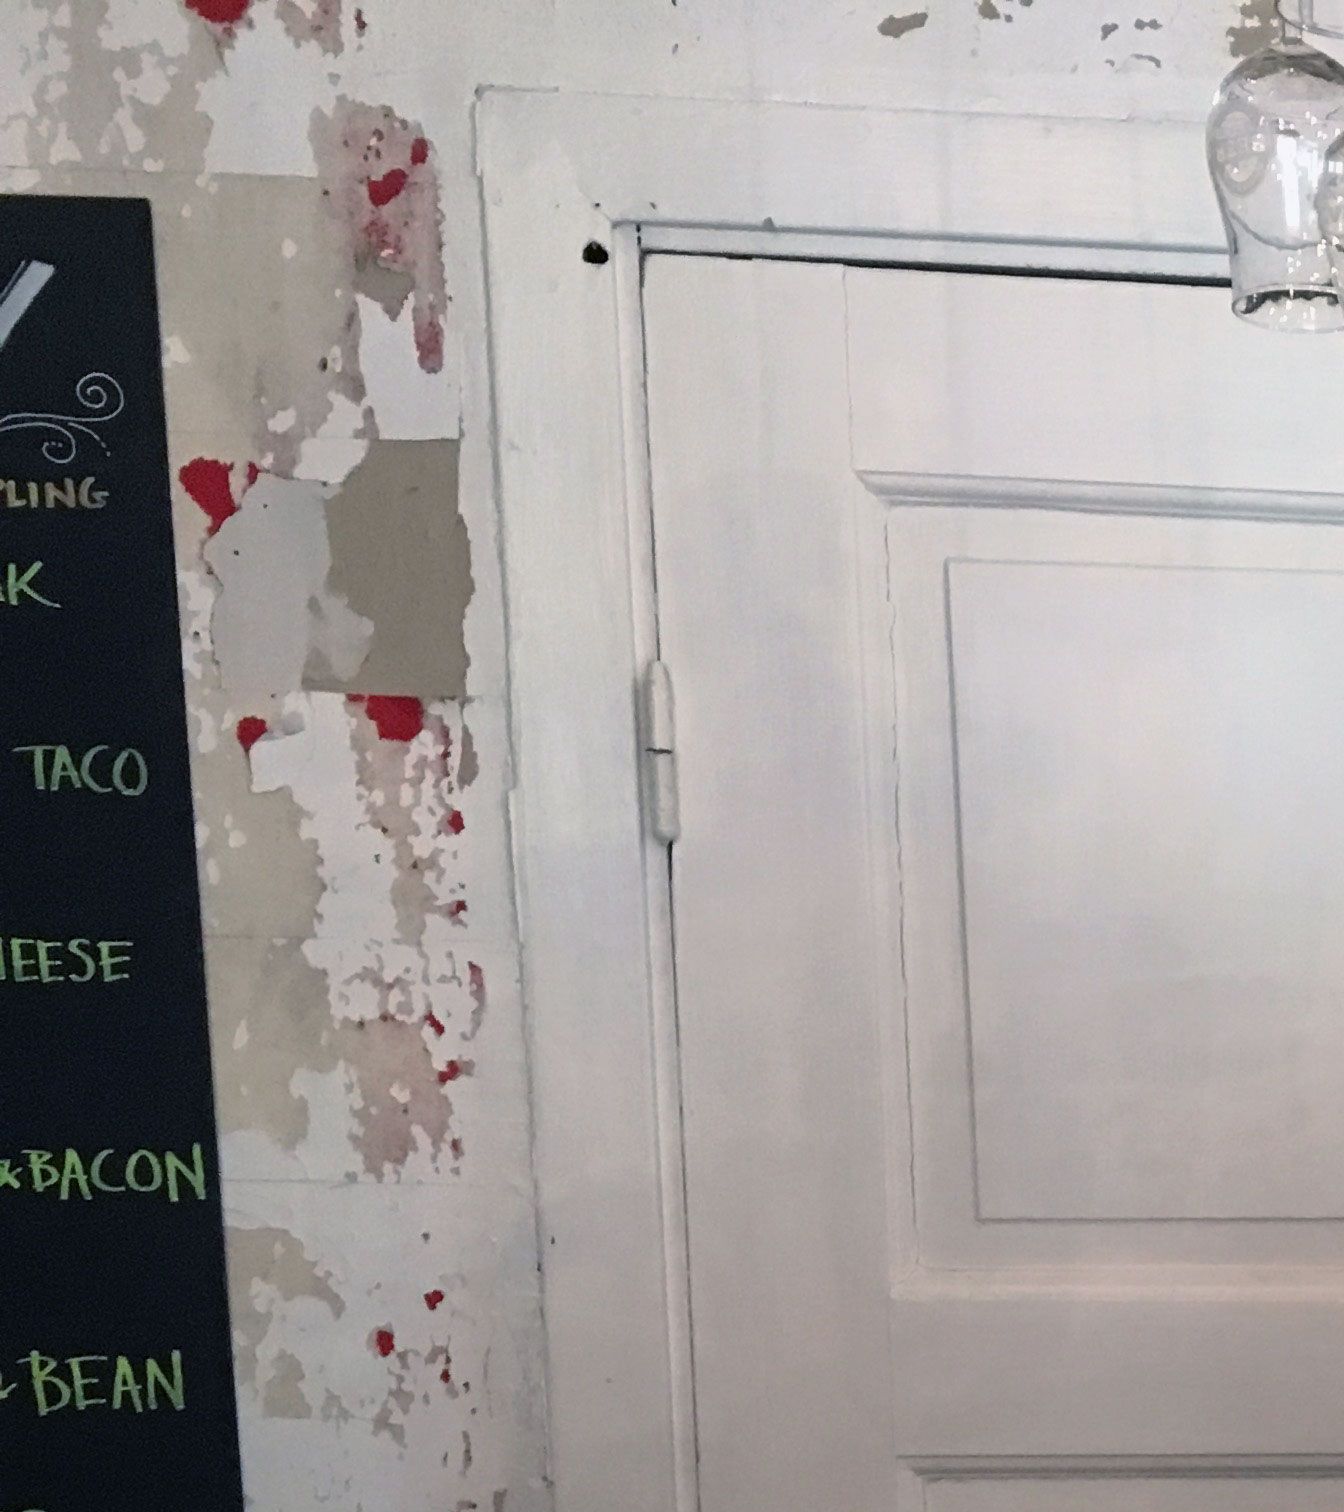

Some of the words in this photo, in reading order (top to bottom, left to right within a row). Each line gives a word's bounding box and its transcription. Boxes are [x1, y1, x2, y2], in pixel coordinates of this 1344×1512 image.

[11, 743, 149, 797] TACO
[22, 1142, 207, 1203] BACON
[16, 1349, 186, 1417] BEAN
